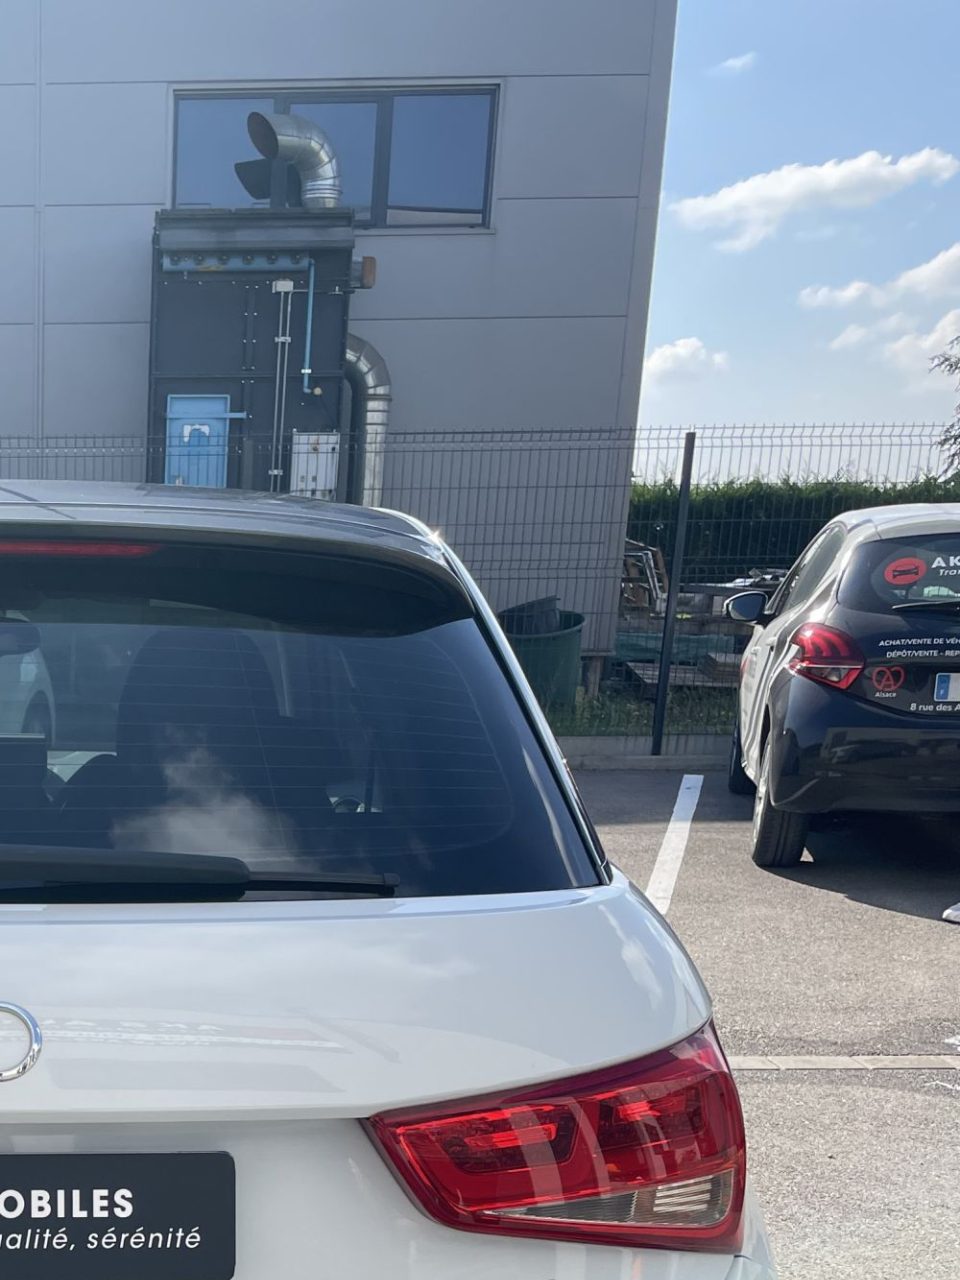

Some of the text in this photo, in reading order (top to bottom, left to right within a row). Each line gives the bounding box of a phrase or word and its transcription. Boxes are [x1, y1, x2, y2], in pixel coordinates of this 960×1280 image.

[910, 703, 917, 711] 8
[936, 703, 953, 711] des
[86, 1226, 202, 1250] sérénité
